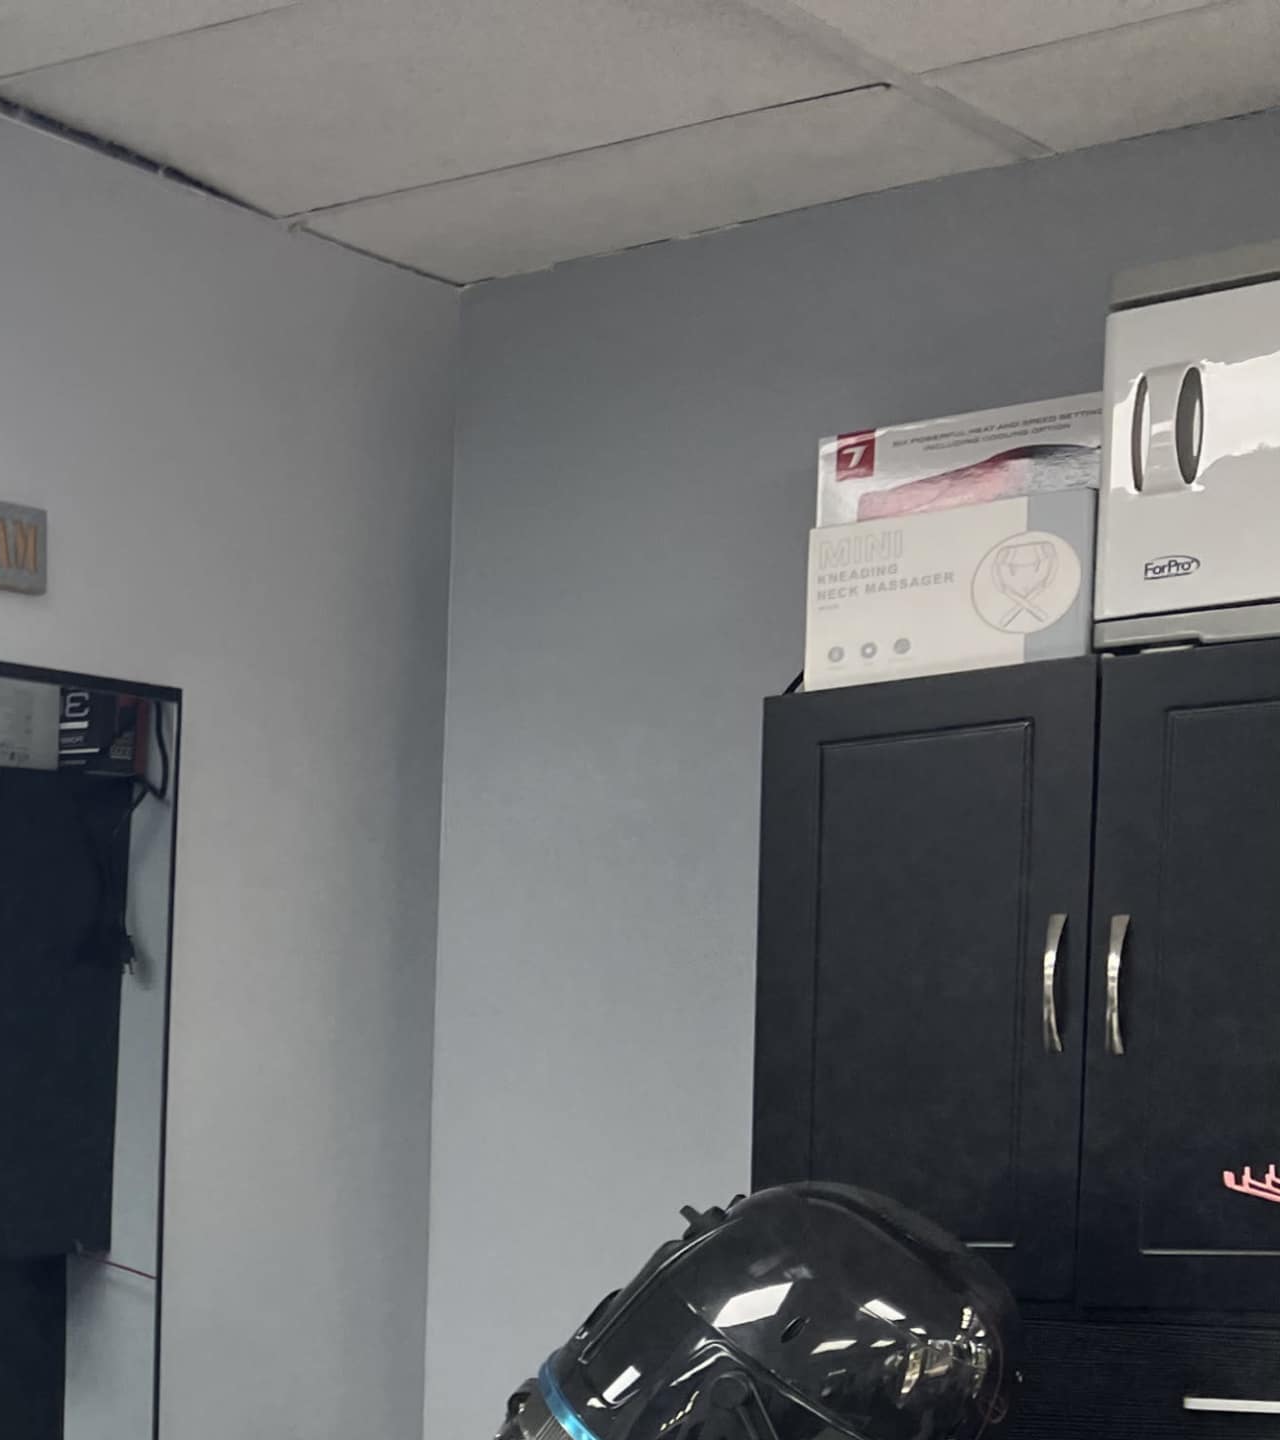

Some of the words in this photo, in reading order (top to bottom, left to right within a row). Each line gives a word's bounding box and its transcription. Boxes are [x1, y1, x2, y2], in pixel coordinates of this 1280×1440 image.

[911, 432, 965, 445] POWERFUL
[969, 427, 996, 436] HEAT
[1022, 416, 1057, 427] SPEED
[1031, 424, 1071, 435] OPTION
[819, 530, 903, 569] MINI
[817, 564, 897, 584] KNEADING
[817, 586, 858, 600] NECK
[865, 572, 954, 593] MASSAGER
